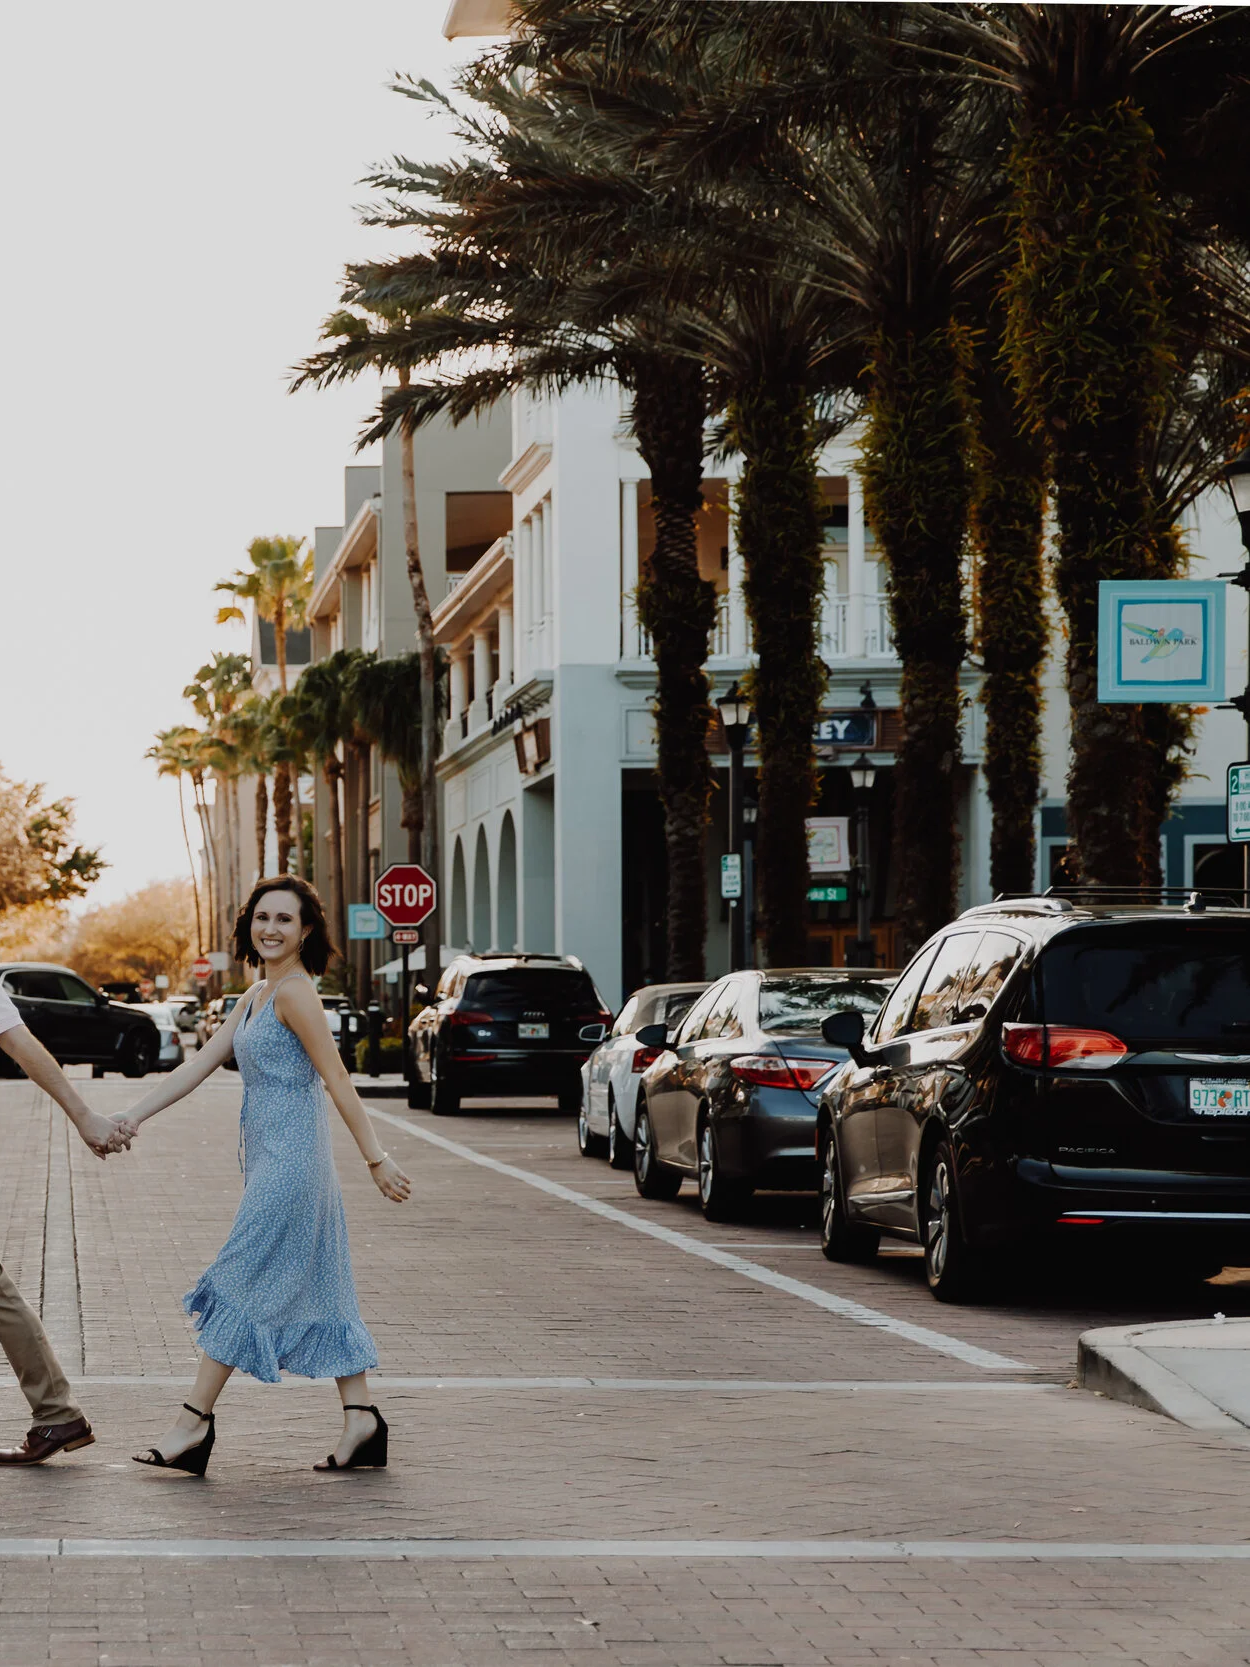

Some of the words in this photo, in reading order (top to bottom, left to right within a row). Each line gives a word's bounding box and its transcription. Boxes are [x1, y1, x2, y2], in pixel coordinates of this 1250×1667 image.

[1174, 638, 1197, 646] PARK
[1231, 774, 1239, 793] 2
[379, 884, 432, 907] STOP
[1193, 1089, 1218, 1107] 973
[1058, 1146, 1117, 1154] PACIFICA
